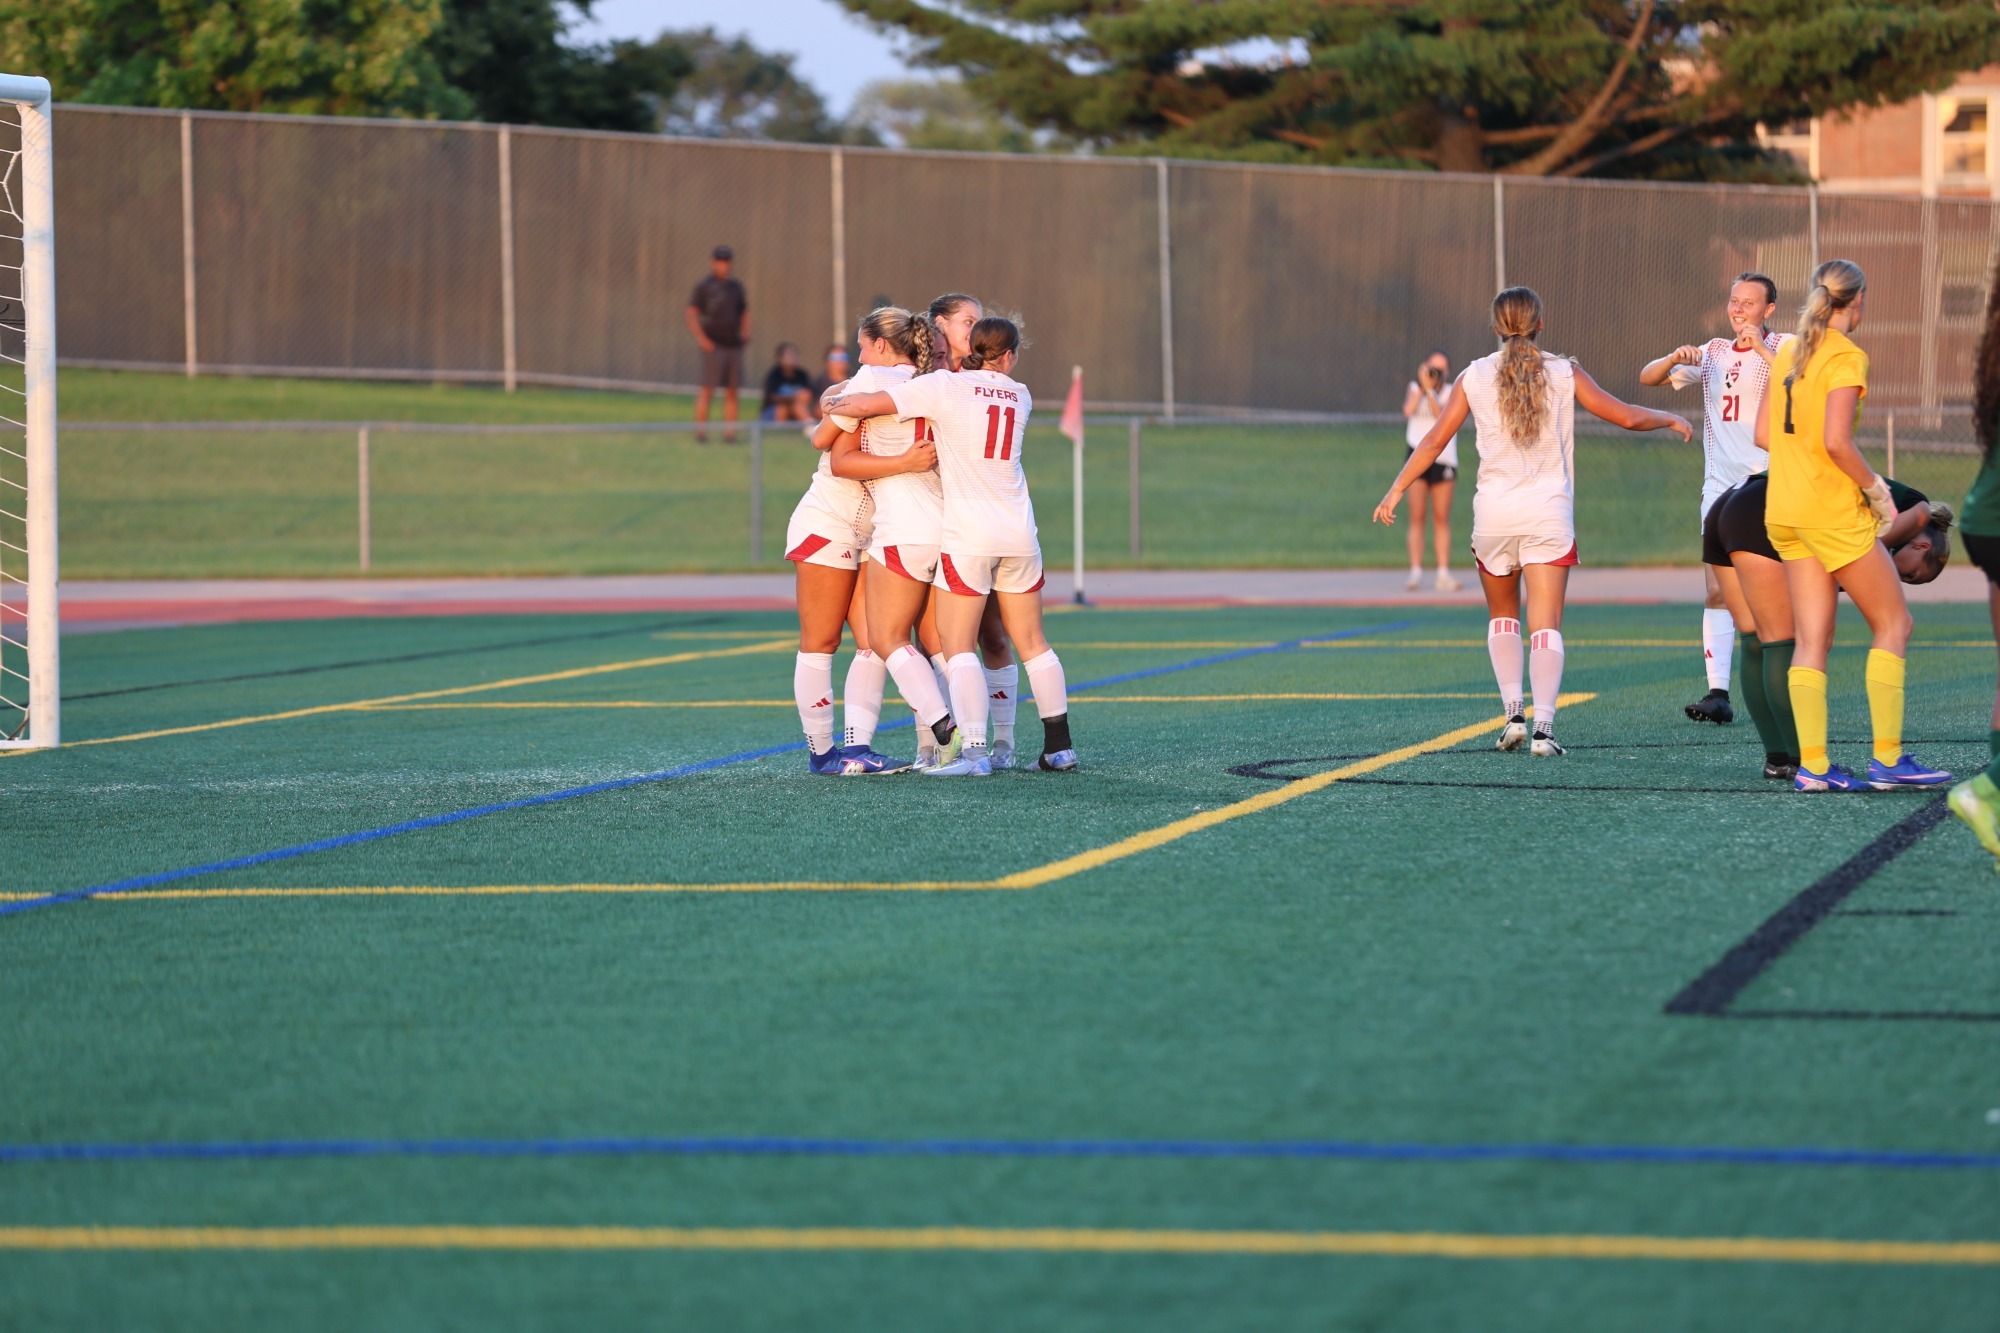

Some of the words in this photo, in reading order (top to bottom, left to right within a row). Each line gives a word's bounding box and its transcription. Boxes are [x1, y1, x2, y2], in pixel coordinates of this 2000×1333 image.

[974, 386, 1018, 402] FLYERS
[1722, 395, 1740, 422] 21
[1782, 377, 1795, 434] 1
[984, 404, 1015, 460] 11
